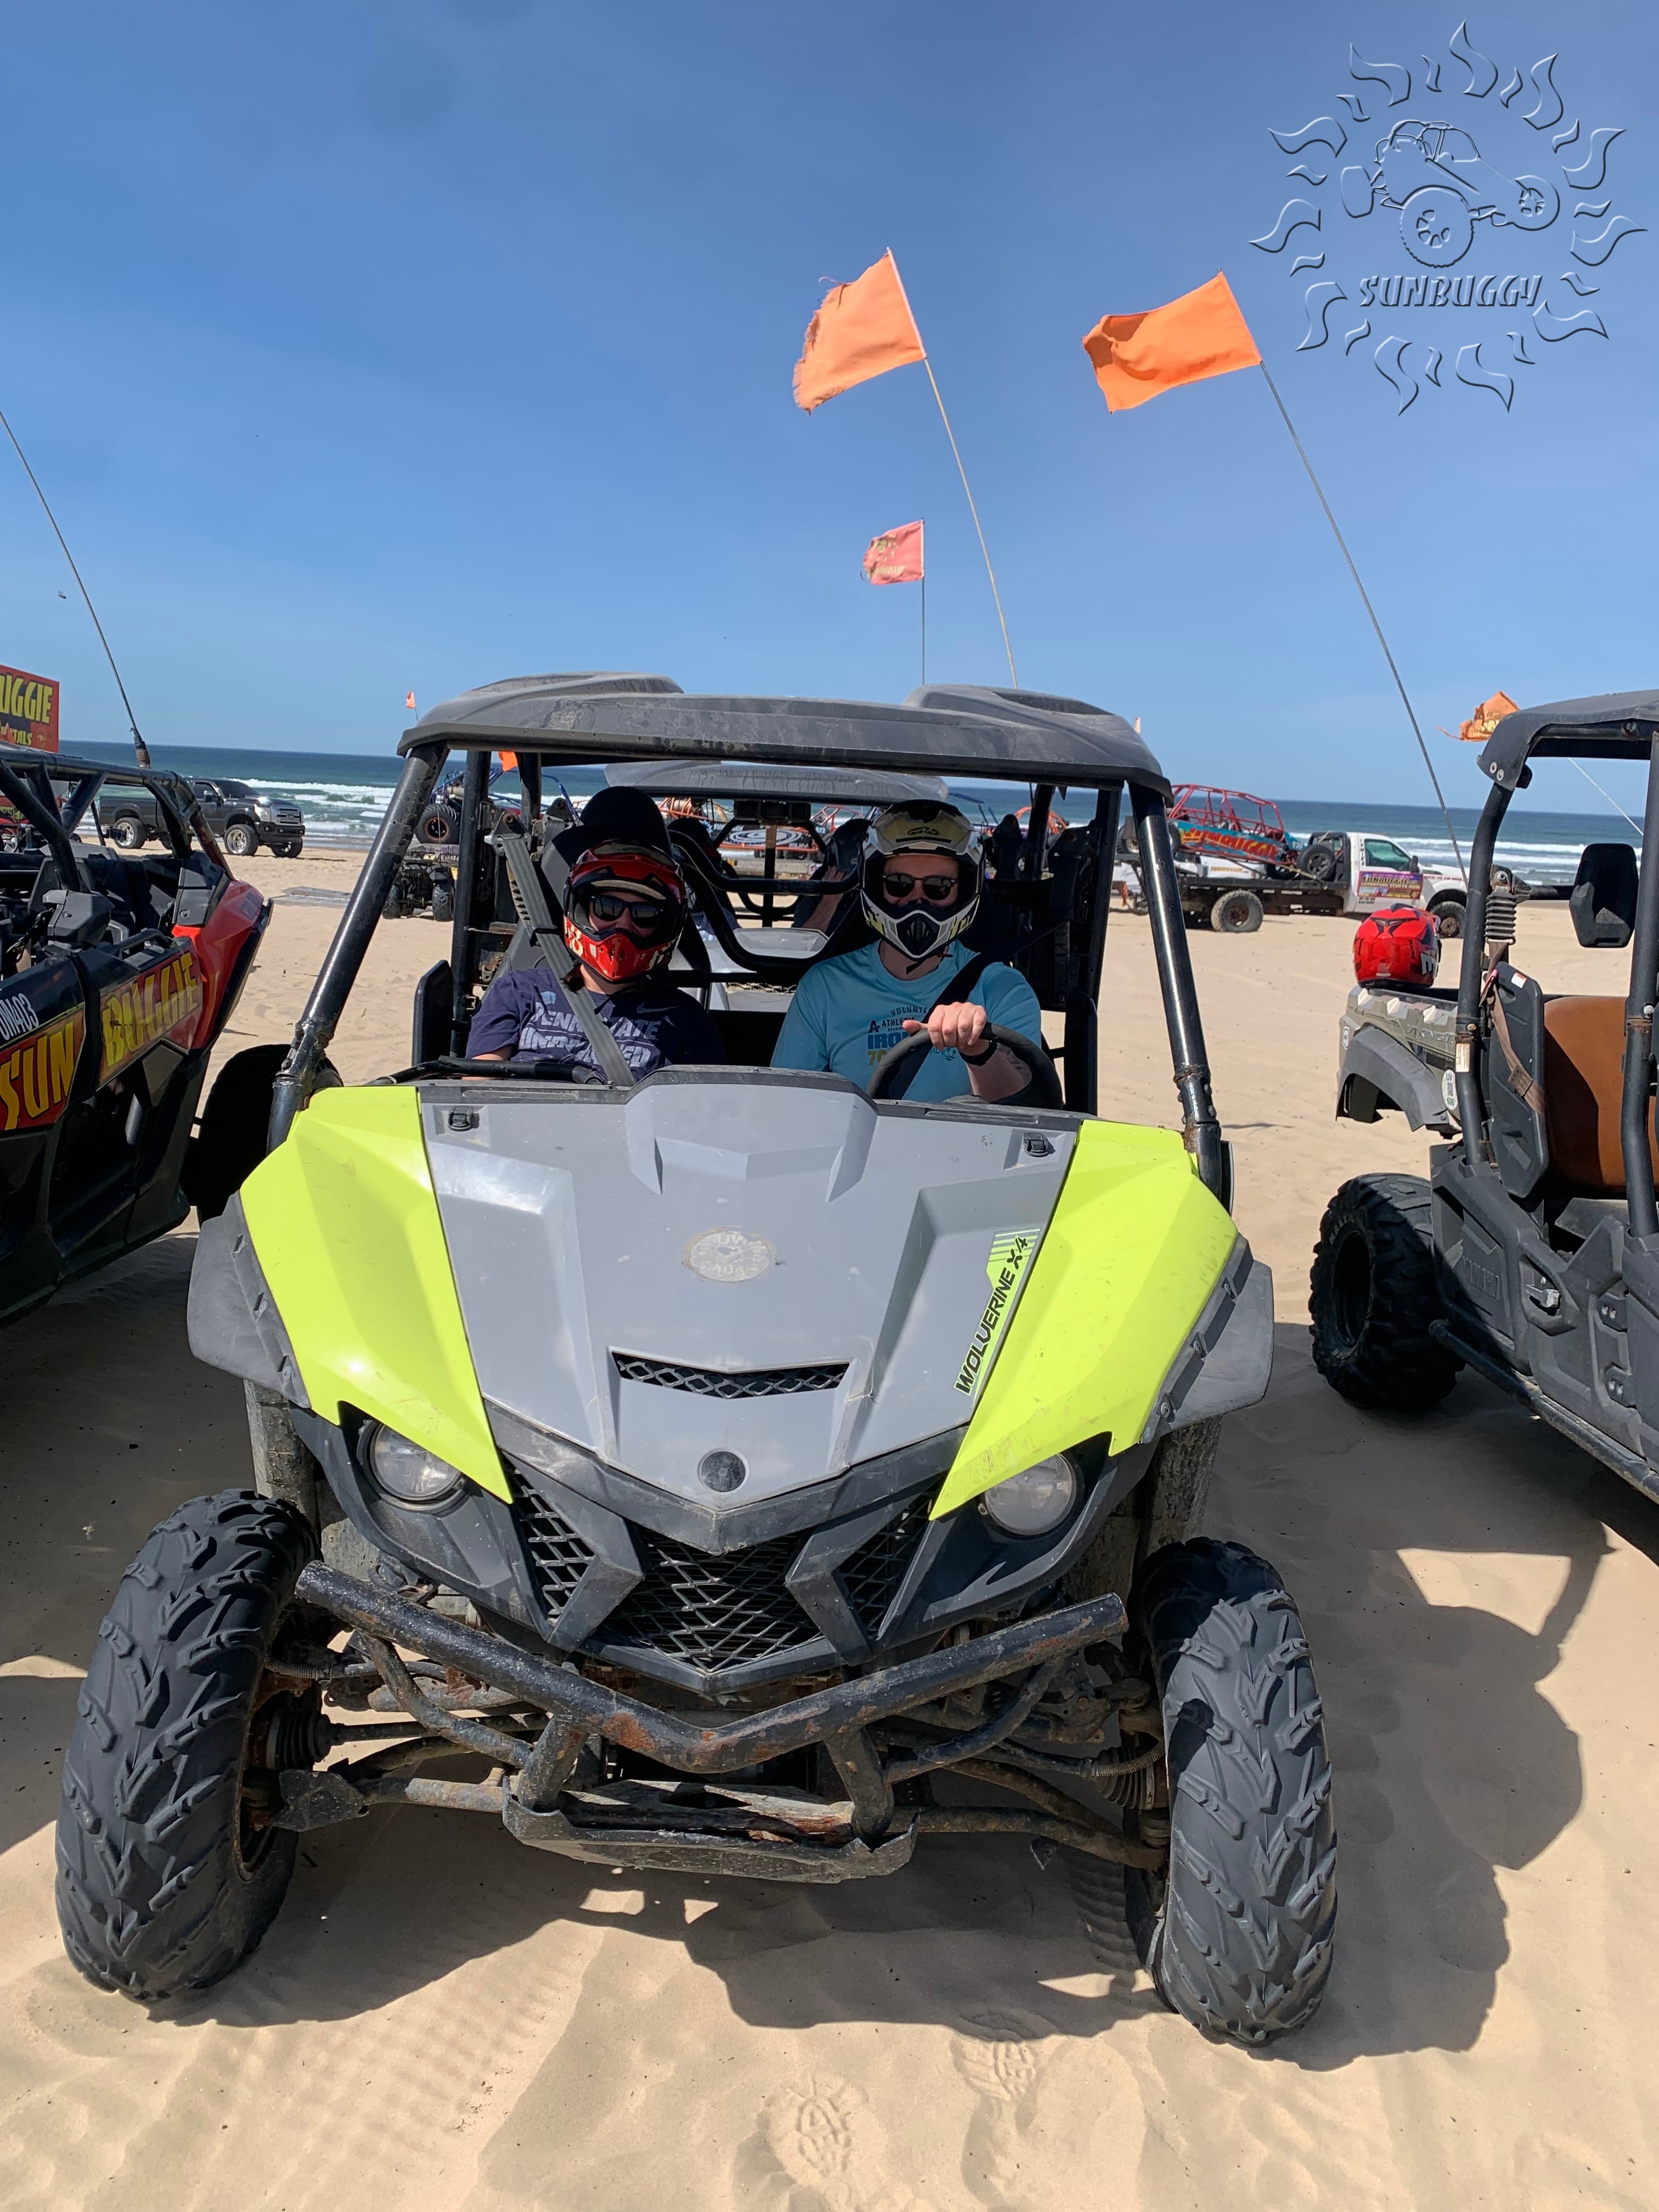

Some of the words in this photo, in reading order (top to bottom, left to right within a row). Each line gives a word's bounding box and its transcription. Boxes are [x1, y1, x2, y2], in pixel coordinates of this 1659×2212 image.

[102, 952, 198, 1066] BUGGIE
[603, 1017, 662, 1041] TATE
[891, 1006, 932, 1016] VOLUNTE
[0, 1021, 74, 1131] SUN
[955, 1267, 1016, 1395] WOLVERINE
[1006, 1235, 1028, 1270] X4
